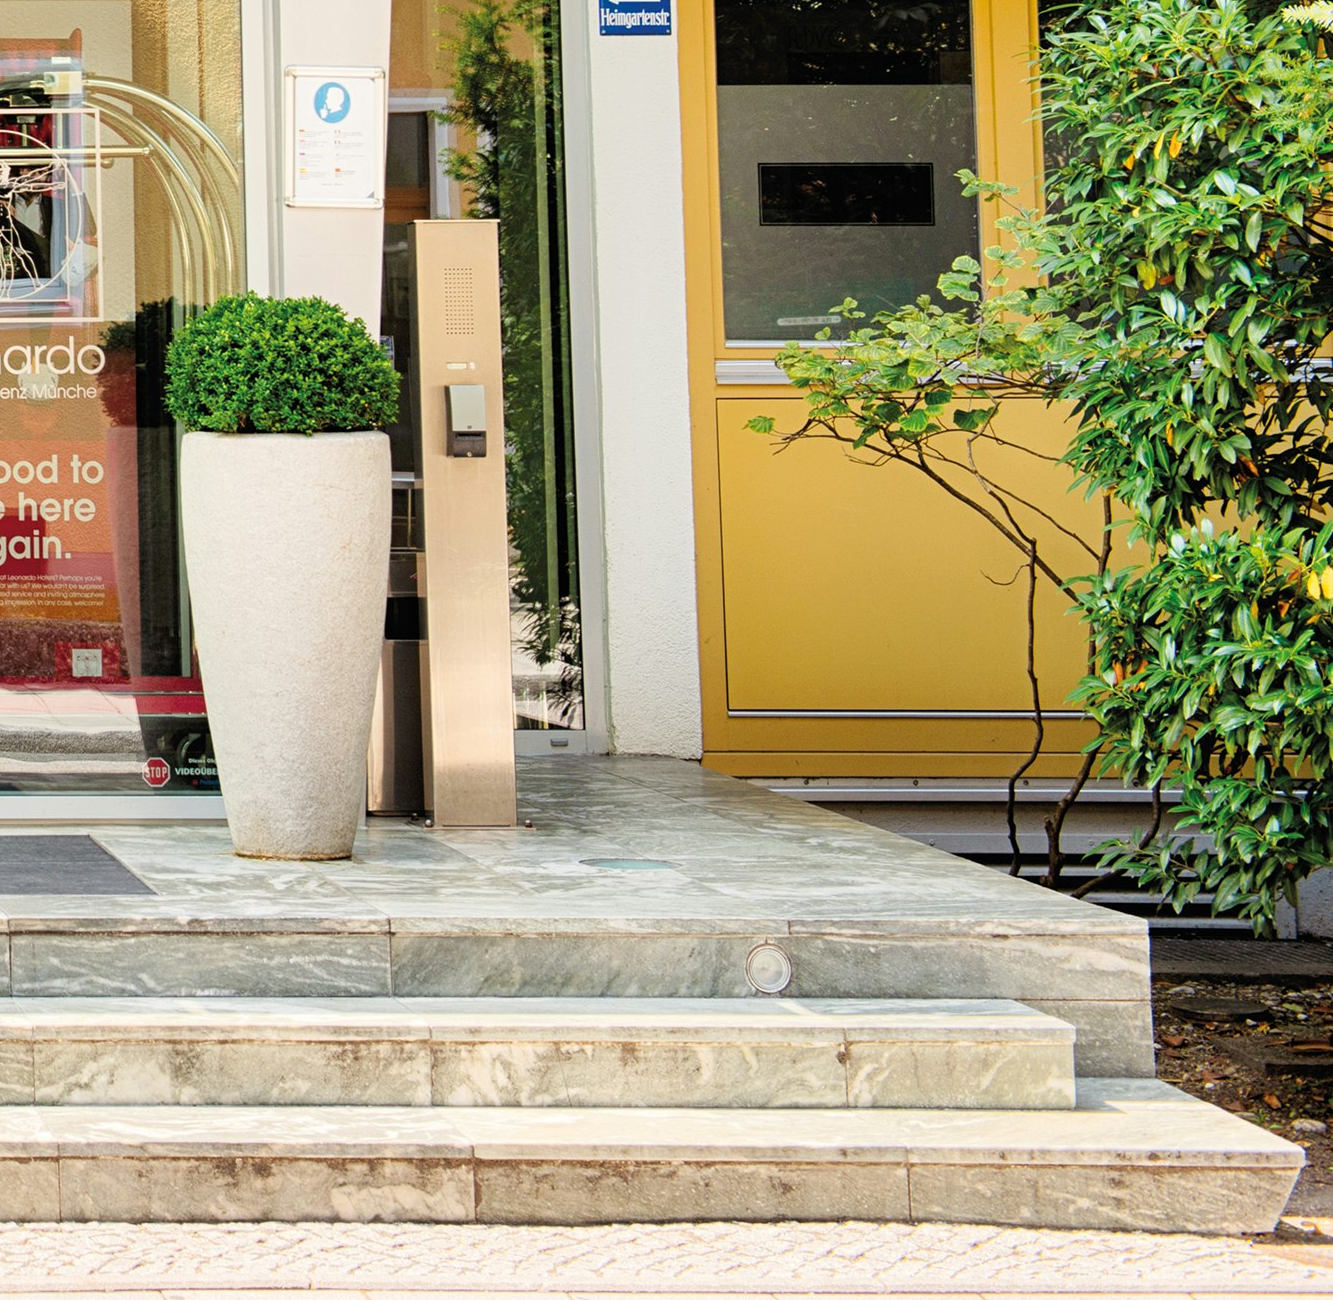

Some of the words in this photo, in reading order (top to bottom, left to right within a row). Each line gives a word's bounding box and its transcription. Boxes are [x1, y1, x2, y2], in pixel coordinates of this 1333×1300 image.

[600, 8, 670, 28] Heimgartenstr.
[70, 454, 104, 484] to
[18, 492, 96, 522] here
[68, 591, 105, 599] atmosphere
[145, 767, 168, 778] STOP
[175, 767, 218, 776] VIDEOÜBE
